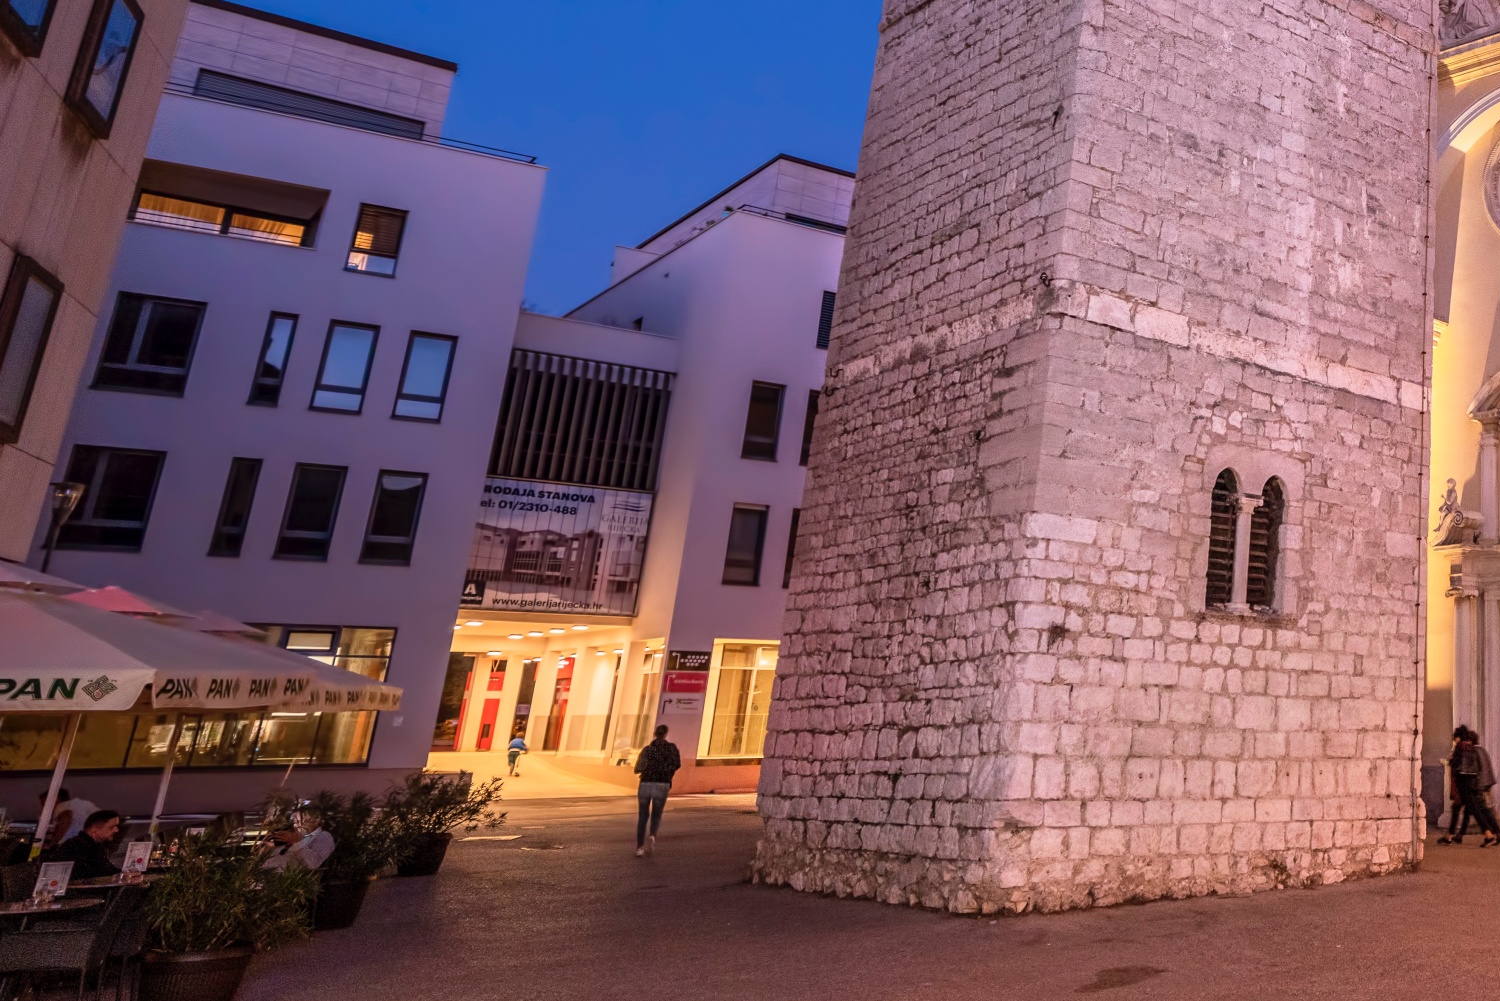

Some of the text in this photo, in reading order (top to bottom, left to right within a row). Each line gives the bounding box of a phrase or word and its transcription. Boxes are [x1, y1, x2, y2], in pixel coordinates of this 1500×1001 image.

[483, 485, 596, 503] RODAJA STANOVA
[480, 499, 578, 515] el: 01/2310-488
[492, 597, 604, 610] www.galerijarijecka.hr
[155, 677, 192, 699] PAN
[206, 678, 233, 699] PAN
[248, 679, 271, 698] PAN
[283, 678, 304, 696] PAN
